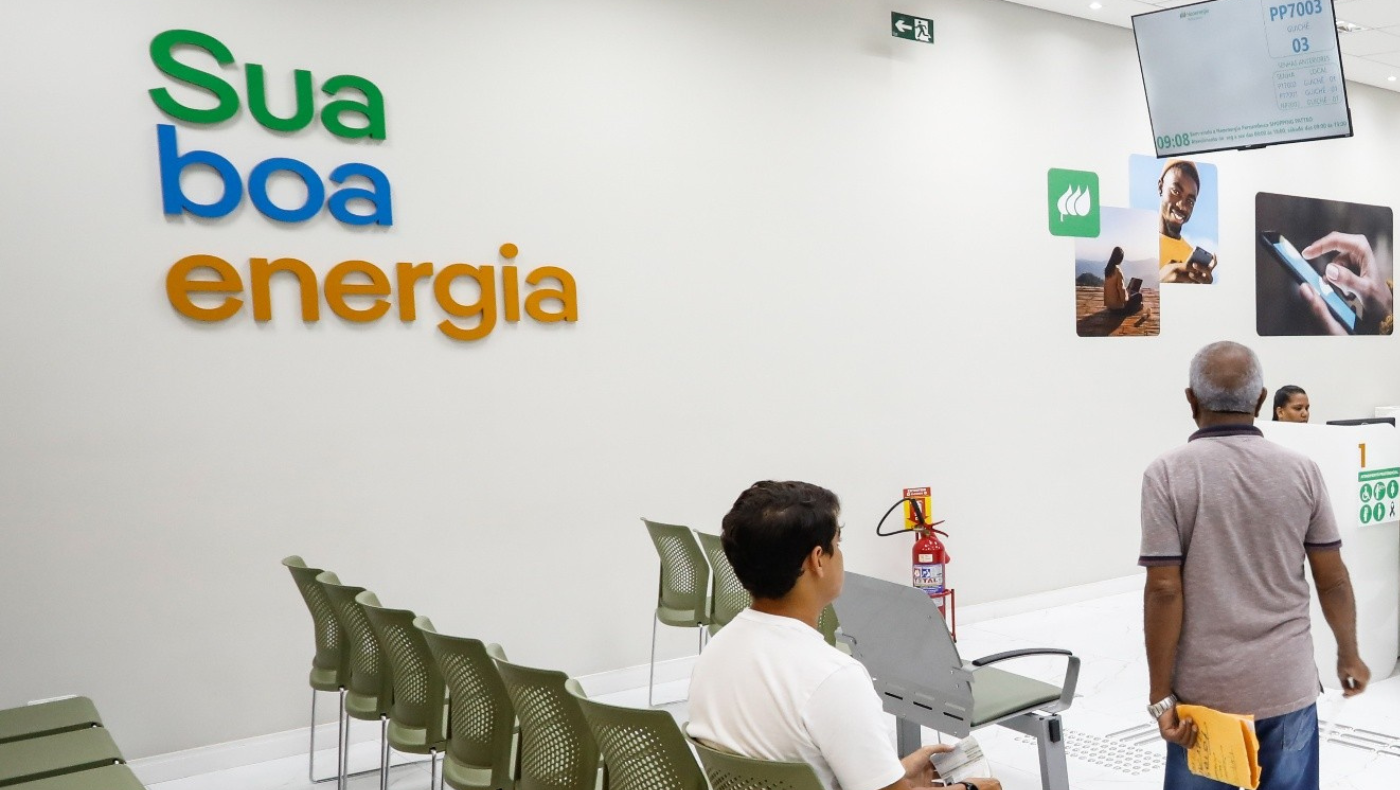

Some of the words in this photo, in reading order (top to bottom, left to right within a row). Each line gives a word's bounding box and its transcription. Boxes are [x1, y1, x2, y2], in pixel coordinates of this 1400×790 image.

[1270, 0, 1322, 21] PP7003
[1292, 37, 1309, 53] 03
[149, 29, 386, 140] Sua
[1157, 133, 1190, 149] 09:08
[157, 124, 393, 226] boa
[166, 243, 577, 341] energia
[1358, 444, 1366, 468] 1
